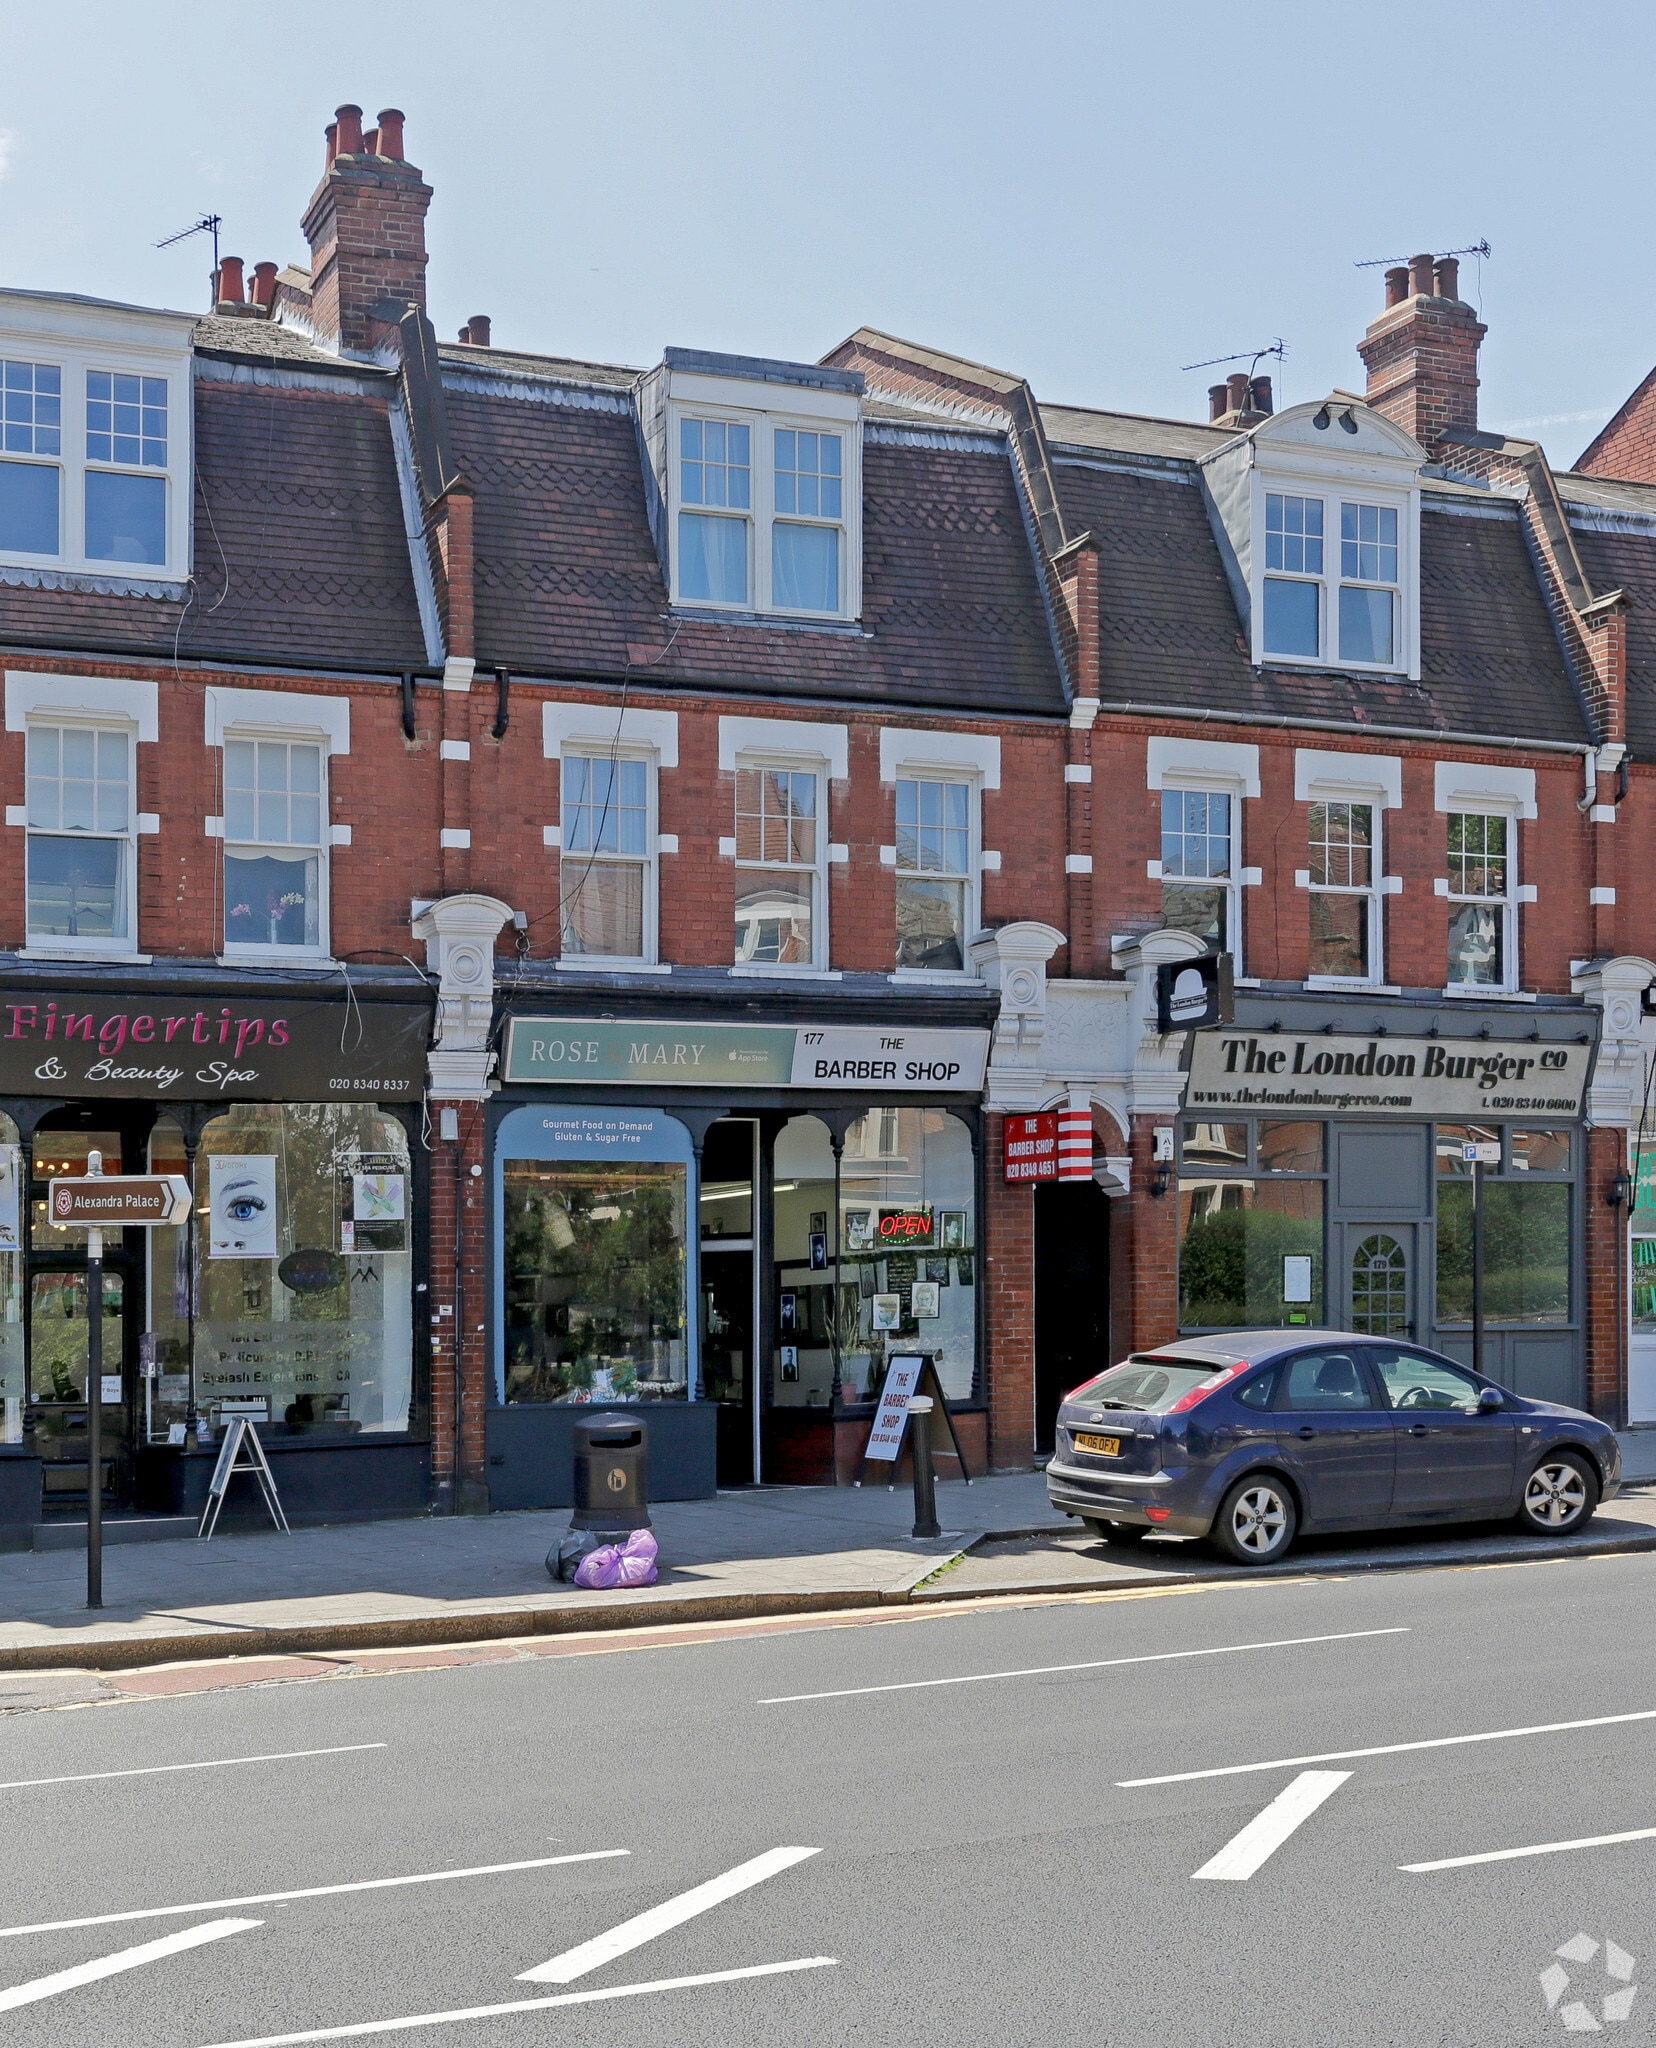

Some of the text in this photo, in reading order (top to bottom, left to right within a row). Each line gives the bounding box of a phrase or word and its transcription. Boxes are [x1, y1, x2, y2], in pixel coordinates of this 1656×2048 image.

[4, 1003, 291, 1058] Fingertips
[803, 1032, 825, 1046] 177
[879, 1037, 905, 1050] THE
[530, 1040, 598, 1063] ROSE
[628, 1042, 707, 1066] MARY
[738, 1054, 769, 1062] App Store
[814, 1059, 961, 1081] BARBER SHOP
[1221, 1039, 1568, 1089] The London Burger co
[34, 1057, 260, 1090] & Beauty Spa
[329, 1078, 410, 1090] 020 8340 8337
[1193, 1088, 1412, 1108] www.thelondonburgerco.com
[1492, 1096, 1514, 1109] 020
[1515, 1097, 1545, 1110] 8340
[1546, 1098, 1577, 1111] 6600
[542, 1119, 653, 1131] Gourmet Food on Demand
[1025, 1119, 1038, 1134] THE
[554, 1132, 641, 1144] Gluten & Sugar Free
[1008, 1138, 1055, 1157] BARBER SHOP
[1006, 1160, 1056, 1178] 020 8348 4651
[74, 1194, 160, 1208] Alexandra Palace
[880, 1216, 932, 1235] OPEN
[1372, 1260, 1387, 1269] 179
[203, 1371, 250, 1386] Eyelash
[895, 1373, 909, 1387] THE
[881, 1414, 900, 1429] SHOP
